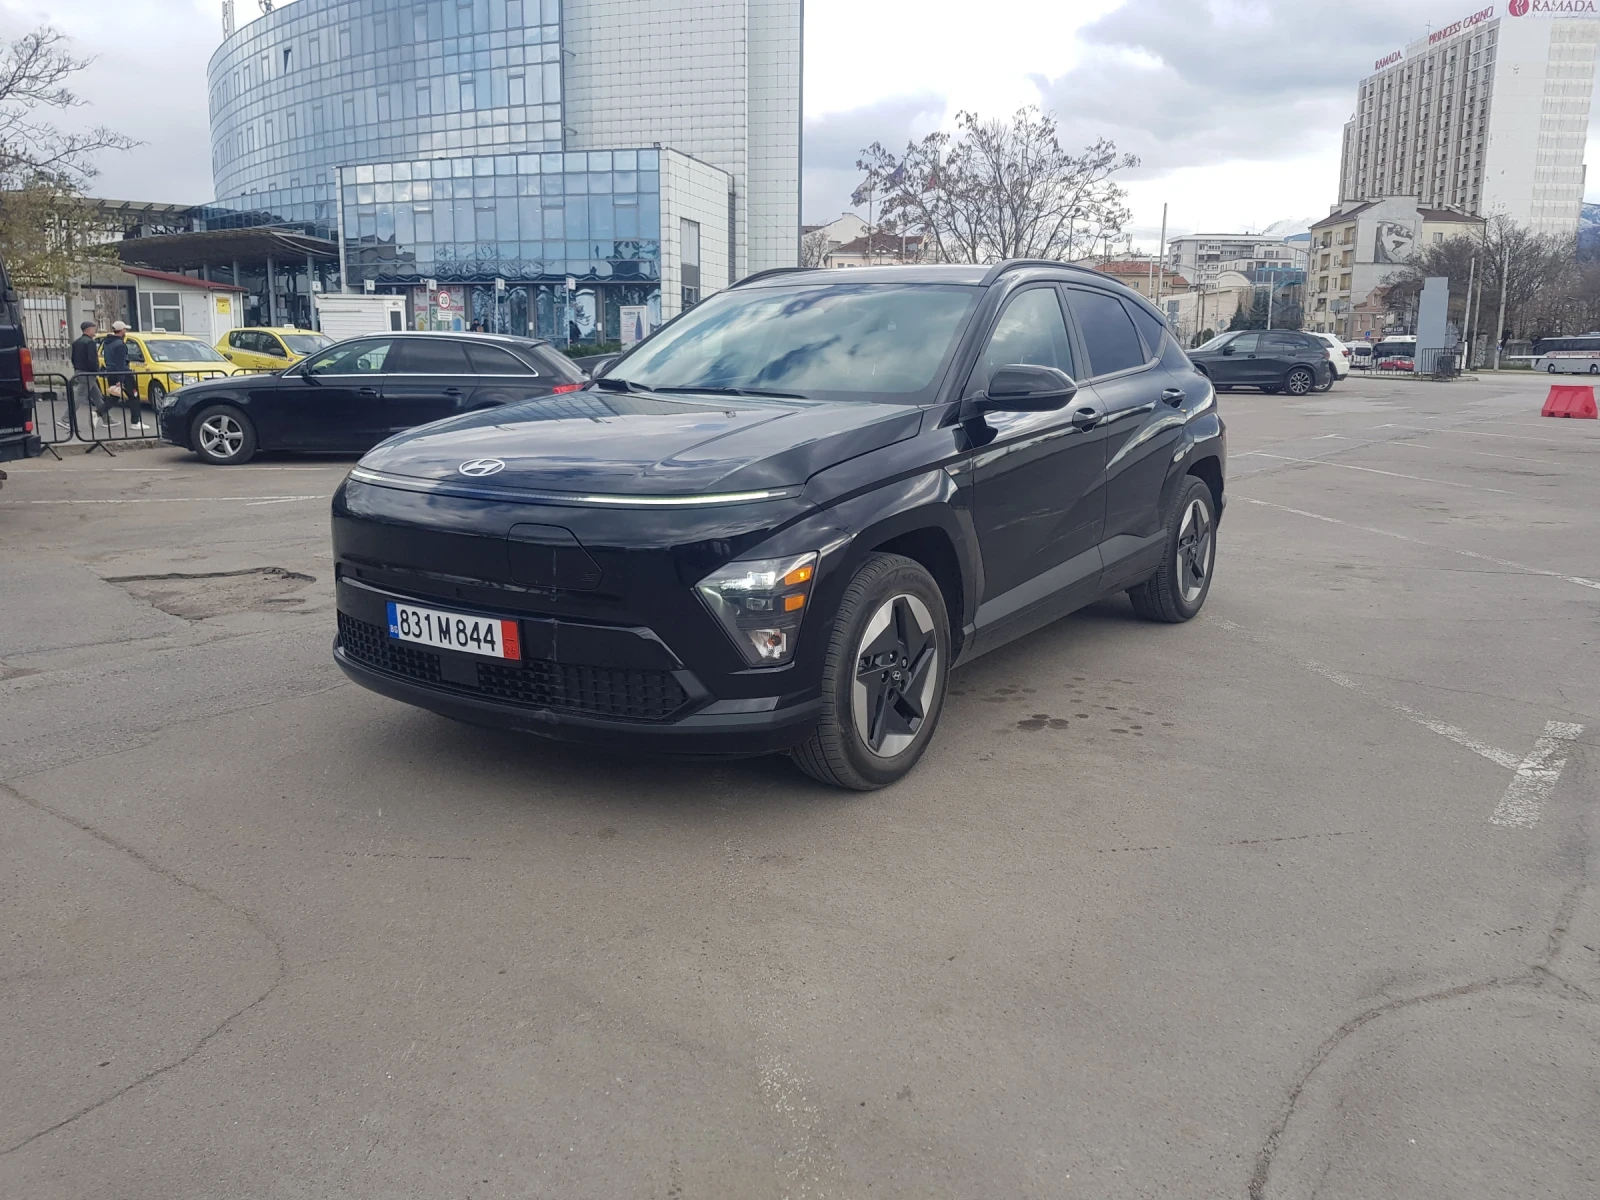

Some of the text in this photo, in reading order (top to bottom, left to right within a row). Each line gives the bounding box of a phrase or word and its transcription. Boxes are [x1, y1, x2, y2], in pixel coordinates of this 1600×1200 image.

[1532, 0, 1594, 12] RAMADA
[1428, 6, 1494, 45] PRINCESS CASINO
[1375, 50, 1402, 71] RAMADA
[390, 624, 399, 634] BG
[505, 645, 516, 655] 26
